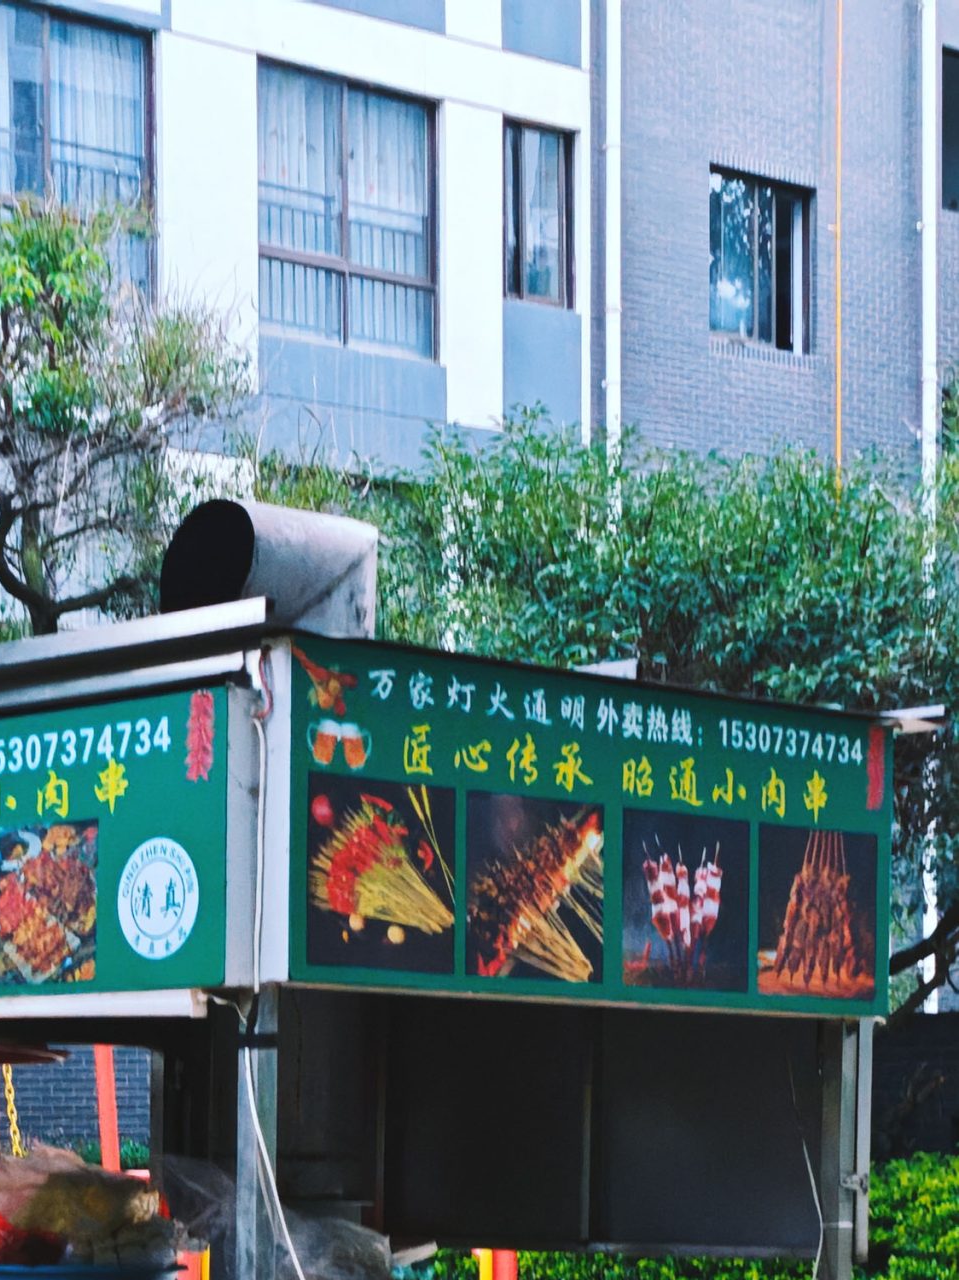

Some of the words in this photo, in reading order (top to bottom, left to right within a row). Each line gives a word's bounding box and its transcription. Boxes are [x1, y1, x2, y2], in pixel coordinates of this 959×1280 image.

[718, 718, 864, 766] 15307374734
[402, 723, 593, 792] 匠心传承
[622, 755, 829, 824] 昭通小肉串
[133, 876, 182, 919] 清真
